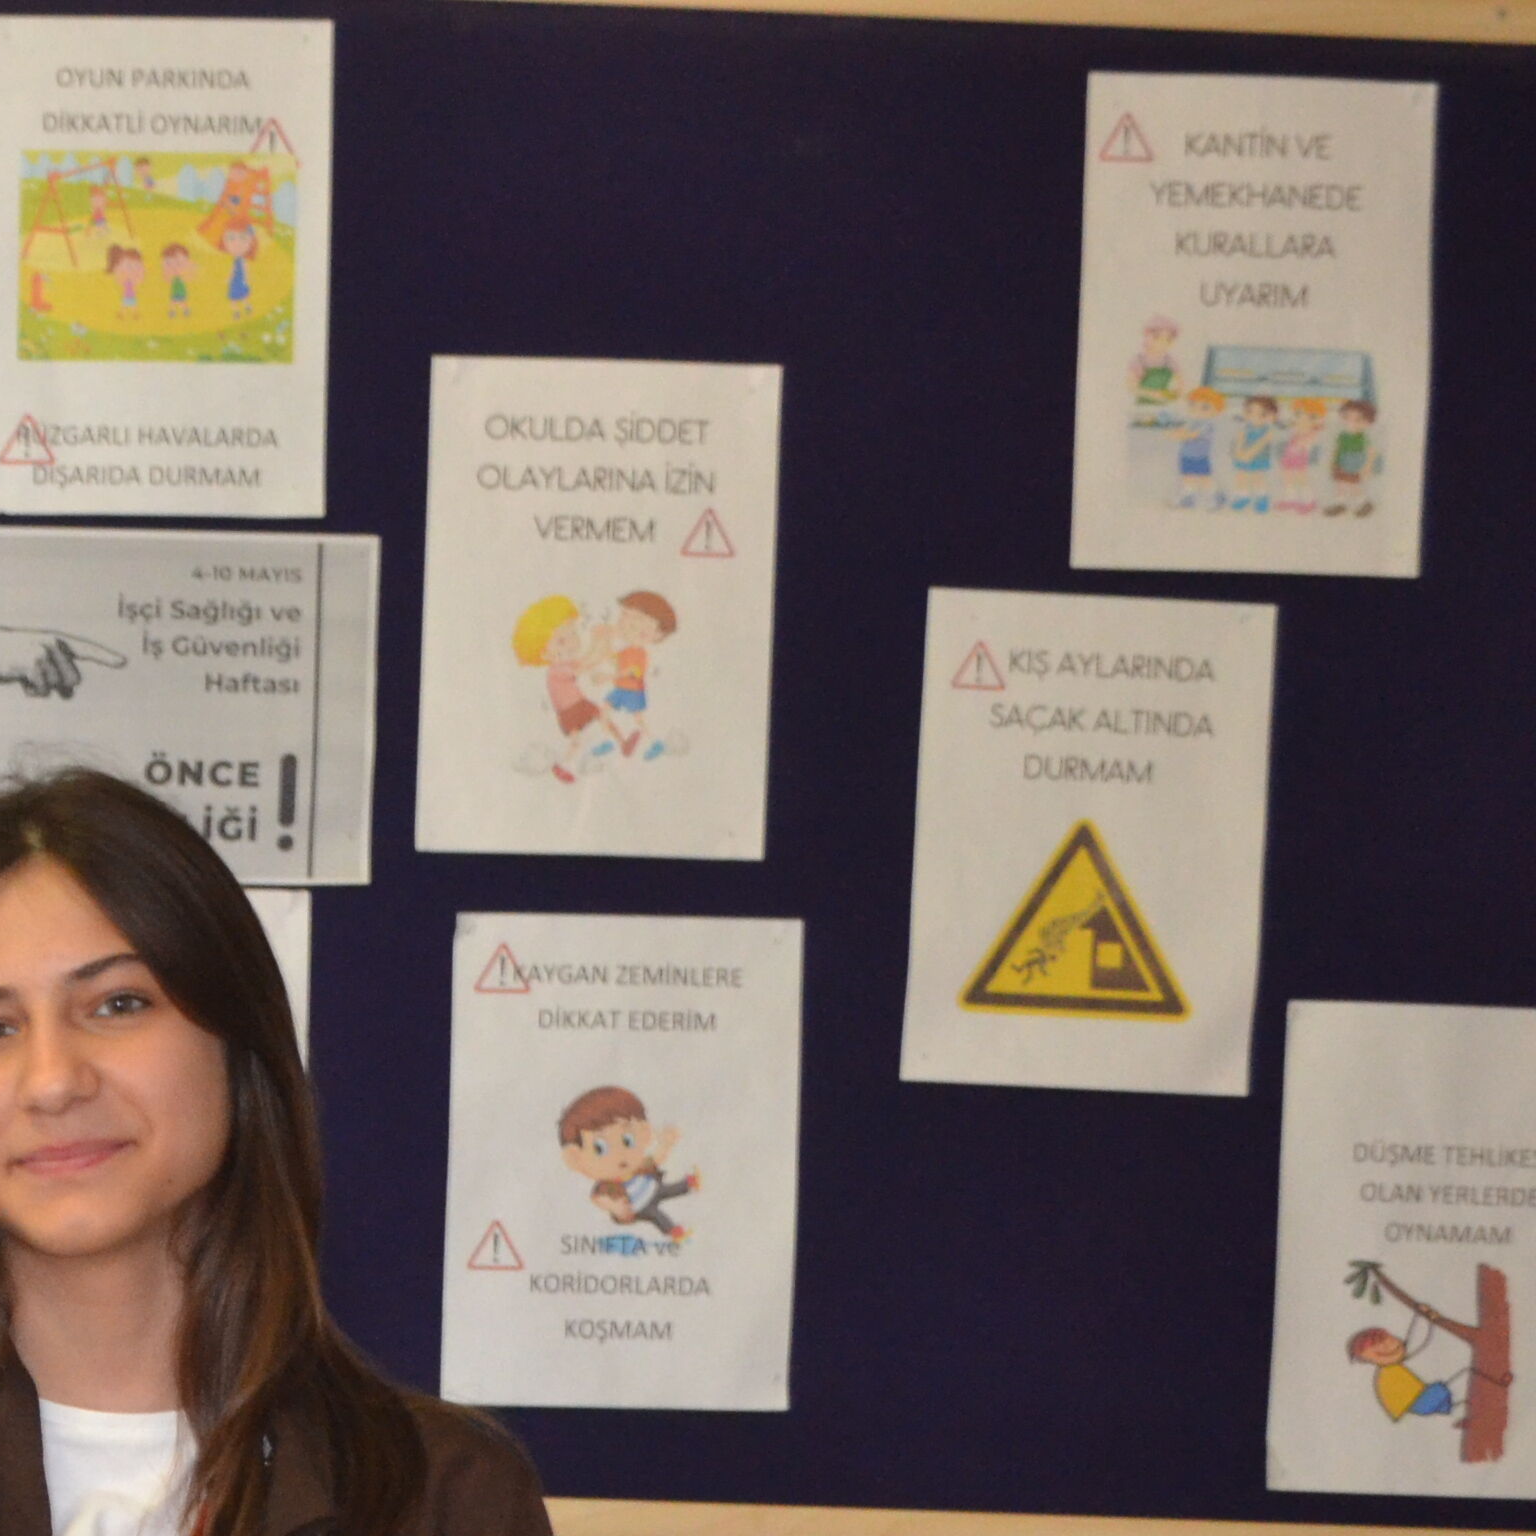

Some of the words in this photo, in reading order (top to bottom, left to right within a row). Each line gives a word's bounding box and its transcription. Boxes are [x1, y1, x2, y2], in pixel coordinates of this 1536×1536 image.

[56, 67, 124, 89] OYUN
[132, 69, 250, 90] PARKINDA
[42, 111, 145, 134] DİKKATLİ
[151, 114, 262, 136] OYNARIM
[1184, 126, 1288, 159] KANTİN
[1293, 134, 1333, 160] VE
[1149, 181, 1363, 212] YEMEKHANEDE
[1174, 231, 1335, 259] KURALLARA
[1200, 282, 1308, 309] UYARIM
[138, 424, 278, 448] HAVALARDA
[485, 414, 607, 442] OKULDA
[614, 412, 710, 449] ŞİDDET
[32, 464, 140, 490] DIŞARIDA
[149, 466, 261, 486] DURMAM
[477, 463, 656, 493] OLAYLARINA
[665, 463, 716, 495] İZİN
[534, 516, 656, 543] VERMEM
[192, 567, 231, 582] 4-10
[239, 567, 303, 583] MAYIS
[118, 594, 162, 623] İşçi
[171, 600, 262, 626] Sağlığı
[271, 608, 302, 623] ve
[142, 631, 164, 659] İş
[172, 635, 301, 661] Güvenliği
[1008, 649, 1049, 681] KIŞ
[1055, 651, 1215, 683] AYLARINDA
[205, 672, 300, 695] Haftası
[989, 703, 1087, 737] SAÇAK
[1093, 707, 1215, 738] ALTINDA
[145, 753, 260, 789] ÖNCE
[1023, 754, 1155, 784] DURMAM
[513, 965, 608, 987] KAYGAN
[616, 962, 744, 988] ZEMİNLERE
[538, 1009, 622, 1031] DİKKAT
[628, 1011, 718, 1032] EDERİM
[1353, 1139, 1435, 1169] DÜŞME
[1360, 1182, 1423, 1203] OLAN
[560, 1235, 647, 1257] SINIFTA
[654, 1241, 681, 1257] ve
[1384, 1223, 1512, 1246] OYNAMAM
[529, 1272, 711, 1296] KORİDORLARDA
[564, 1319, 672, 1344] KOŞMAM
